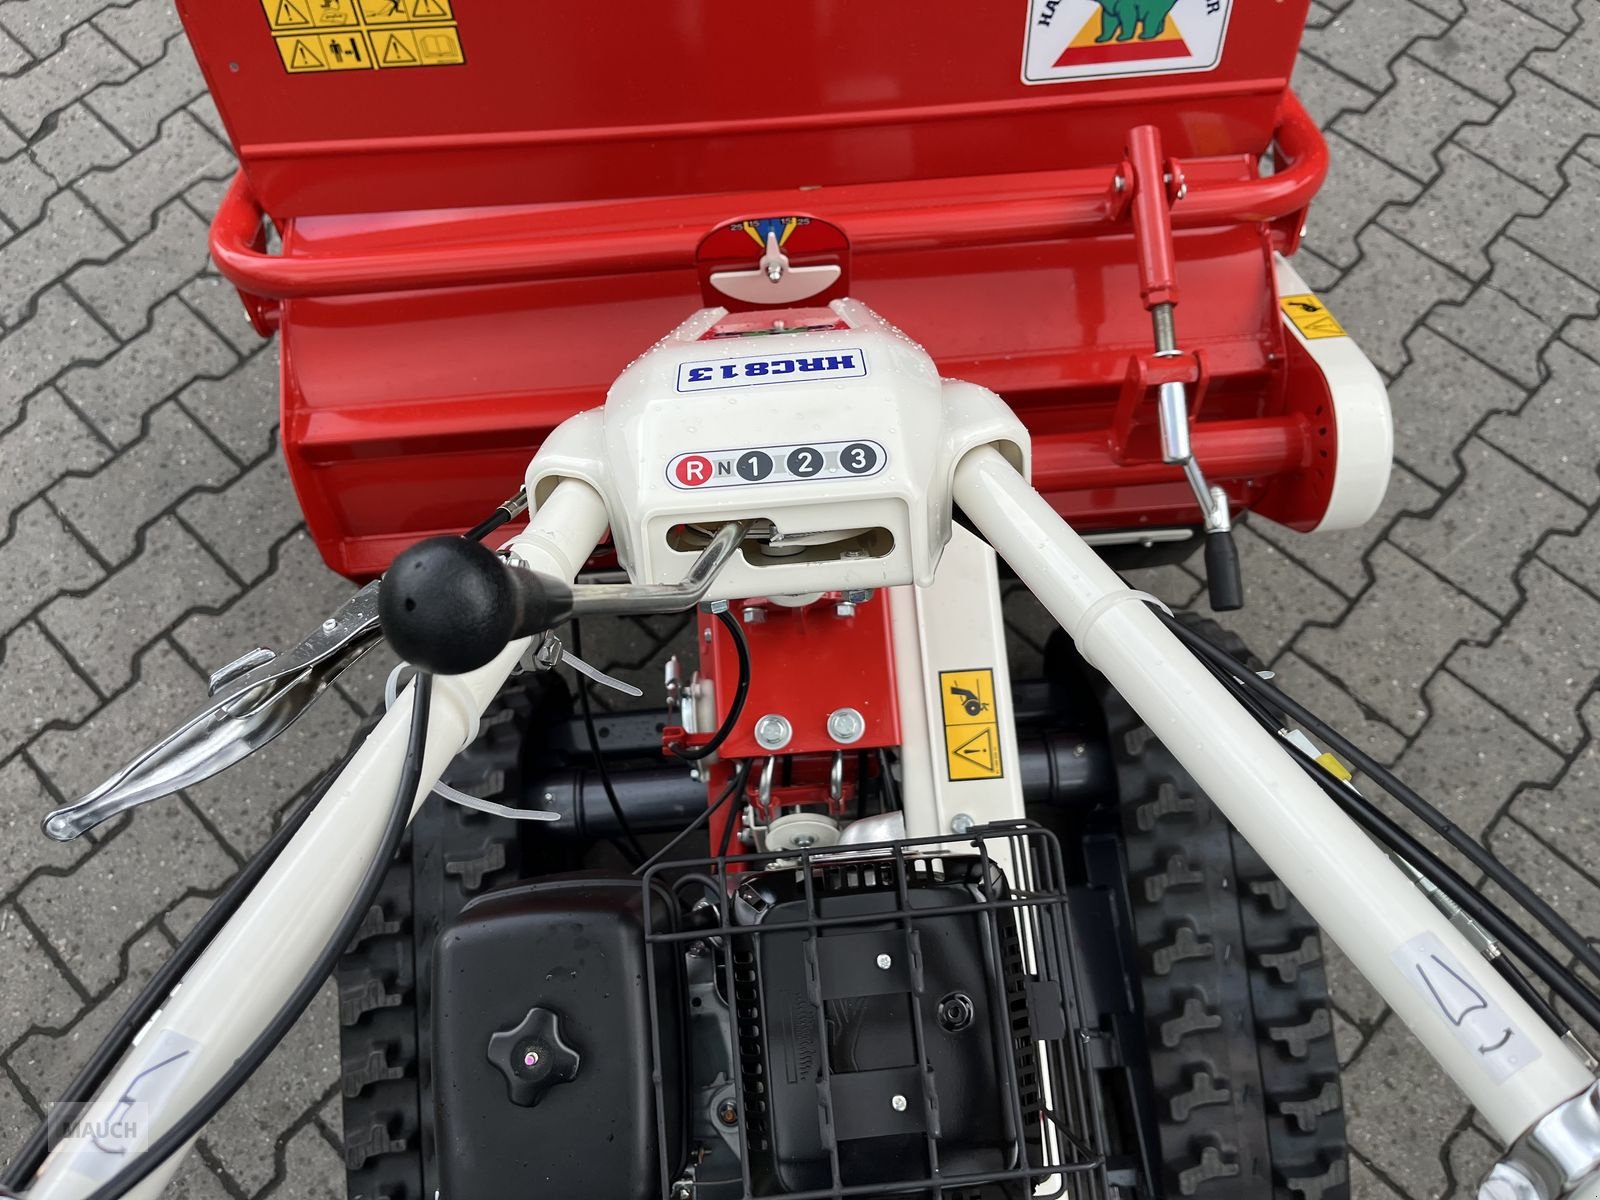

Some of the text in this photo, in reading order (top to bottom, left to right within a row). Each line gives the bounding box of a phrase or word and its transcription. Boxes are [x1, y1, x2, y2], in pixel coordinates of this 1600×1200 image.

[730, 223, 744, 232] 25
[687, 355, 856, 383] HRC813
[686, 448, 867, 481] R N 1 2 3
